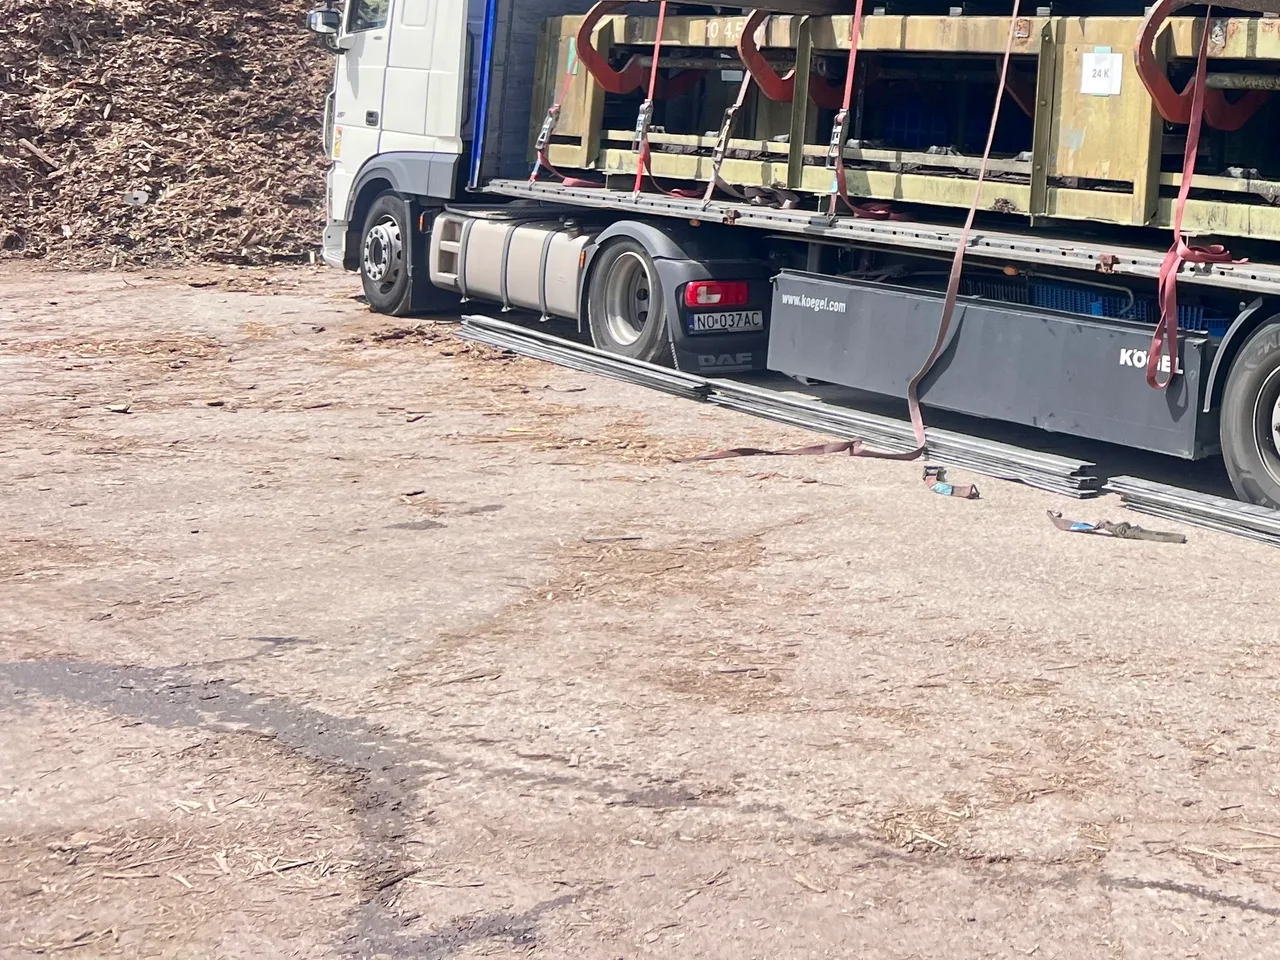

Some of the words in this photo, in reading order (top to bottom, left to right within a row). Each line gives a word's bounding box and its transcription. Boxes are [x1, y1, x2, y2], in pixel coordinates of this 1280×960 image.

[1092, 68, 1102, 79] 24
[1103, 68, 1110, 79] K
[781, 293, 847, 313] www.koegel.com
[697, 315, 715, 329] NO
[719, 312, 760, 328] 037AC
[698, 352, 753, 367] DAF
[1119, 348, 1184, 375] KÖEL
